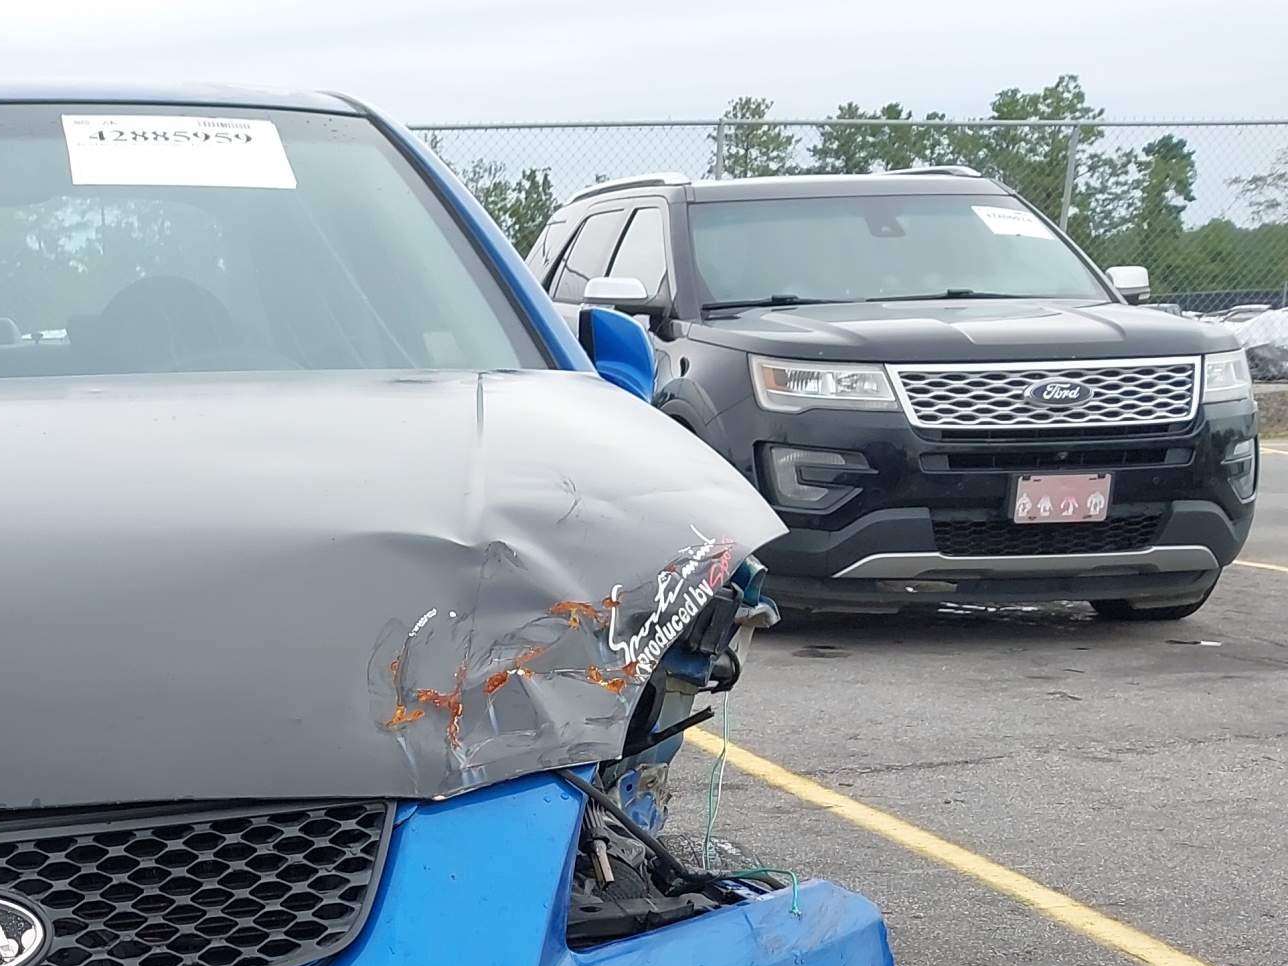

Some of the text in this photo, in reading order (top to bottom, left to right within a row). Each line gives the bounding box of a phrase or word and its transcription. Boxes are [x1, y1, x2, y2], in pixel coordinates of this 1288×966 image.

[88, 129, 253, 144] 42885959
[1042, 383, 1080, 400] Ford
[688, 578, 714, 606] by
